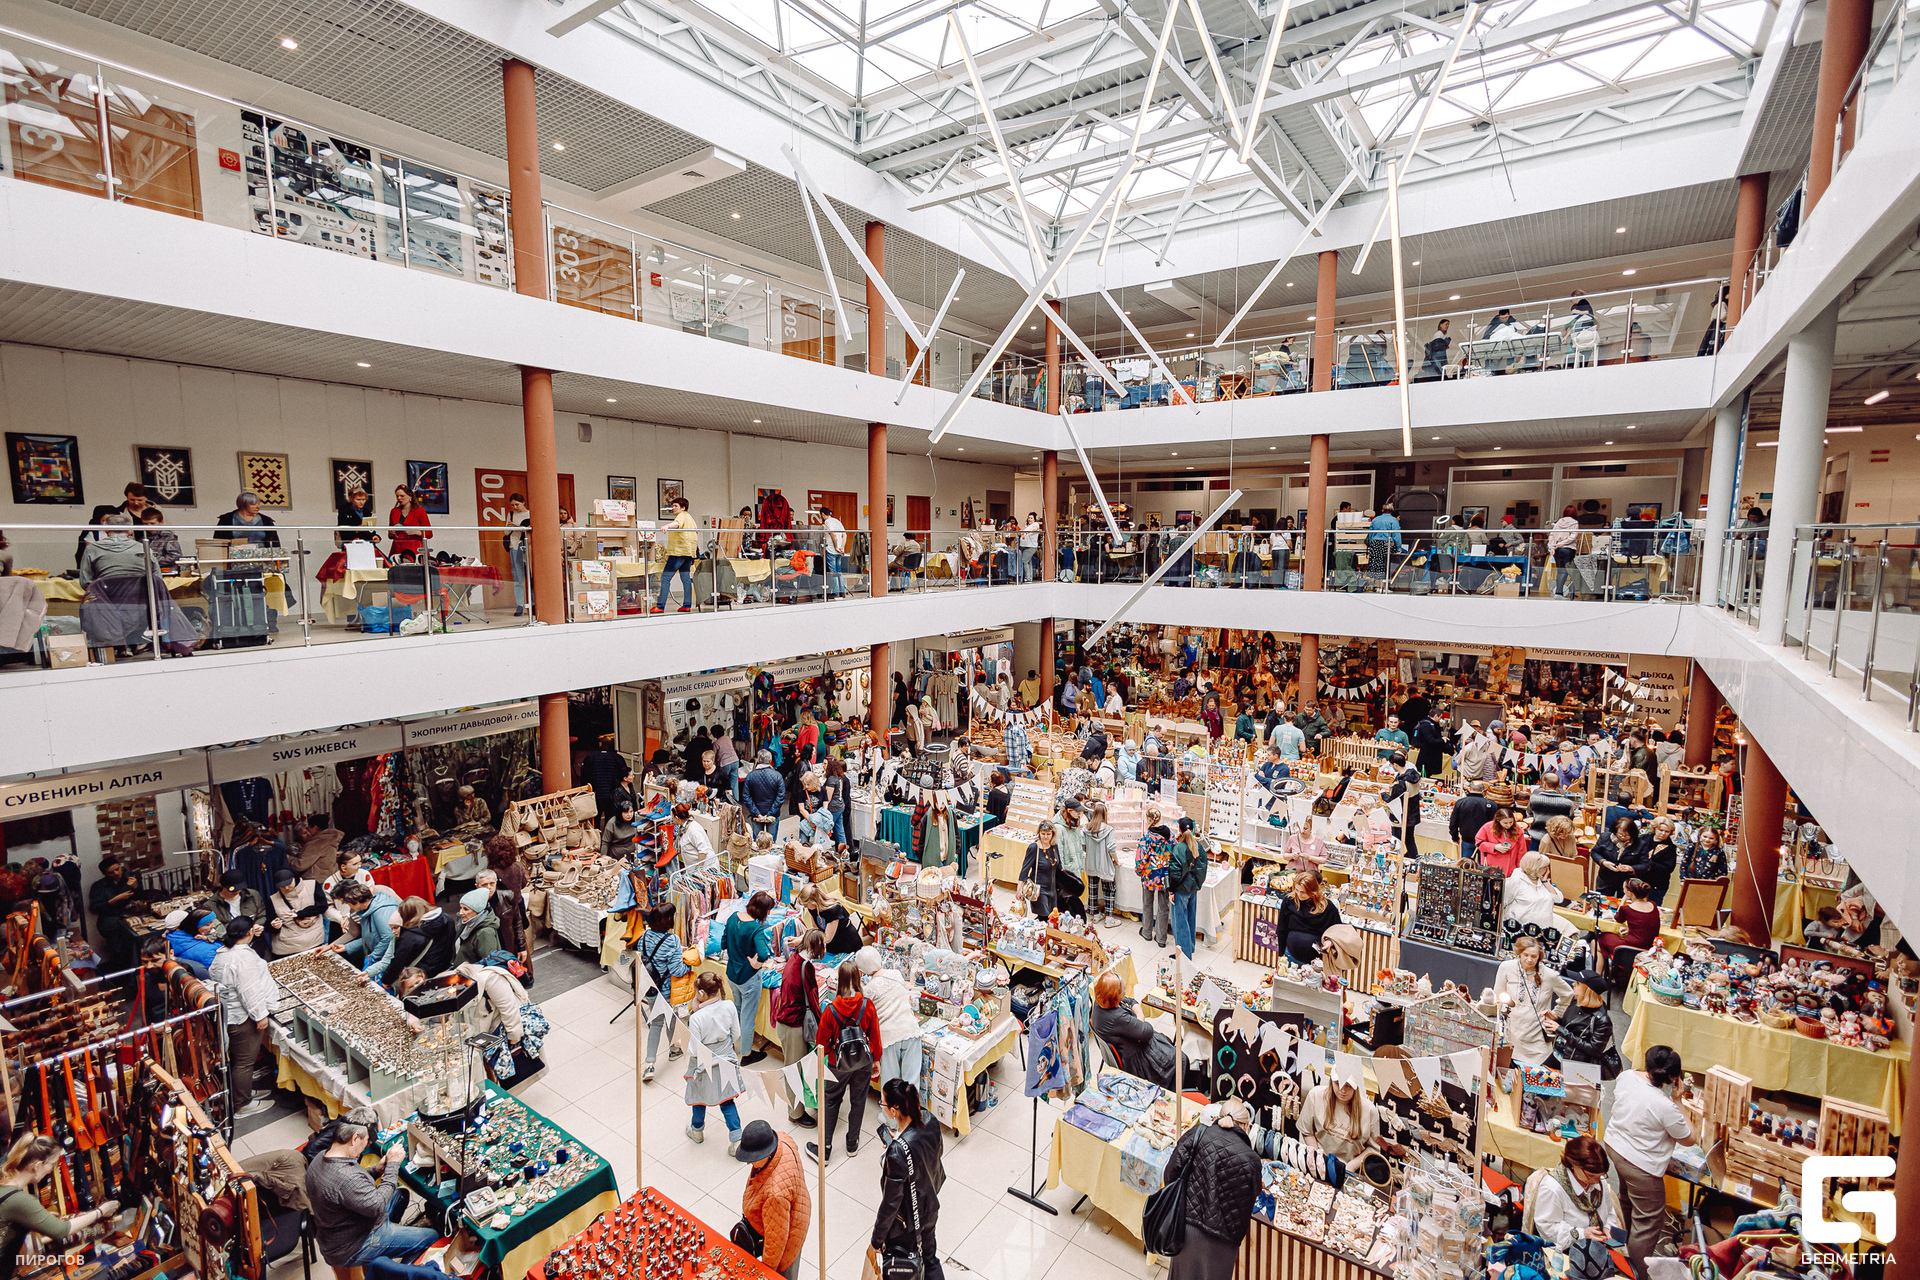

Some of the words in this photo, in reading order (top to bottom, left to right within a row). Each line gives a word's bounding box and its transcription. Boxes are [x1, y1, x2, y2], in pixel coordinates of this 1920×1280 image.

[14, 73, 64, 151] 302
[559, 233, 580, 283] 303
[783, 302, 797, 339] 304
[481, 474, 506, 522] 210
[811, 494, 823, 524] 211
[1455, 643, 1493, 651] ПРОИЗВОДИ
[786, 666, 802, 674] ТЕРЕМ
[841, 656, 863, 666] ПОДНОСЫ
[667, 684, 692, 694] МИЛЫЕ
[694, 681, 717, 689] СЕРДЦУ
[719, 676, 743, 685] ШТУЧКИ
[1640, 671, 1675, 681] ВЫХОД
[1636, 704, 1643, 712] 2
[1645, 706, 1671, 715] ЭТАЖ
[411, 724, 459, 738] ЭКОПРИНТ
[460, 713, 513, 731] ДАВЫДОВОЙ
[521, 710, 539, 719] ОМС
[273, 748, 301, 761] SWS
[305, 740, 357, 756] ИЖЕВСК
[5, 781, 104, 807] СУВЕНИРЫ
[109, 771, 163, 789] АЛТАЯ
